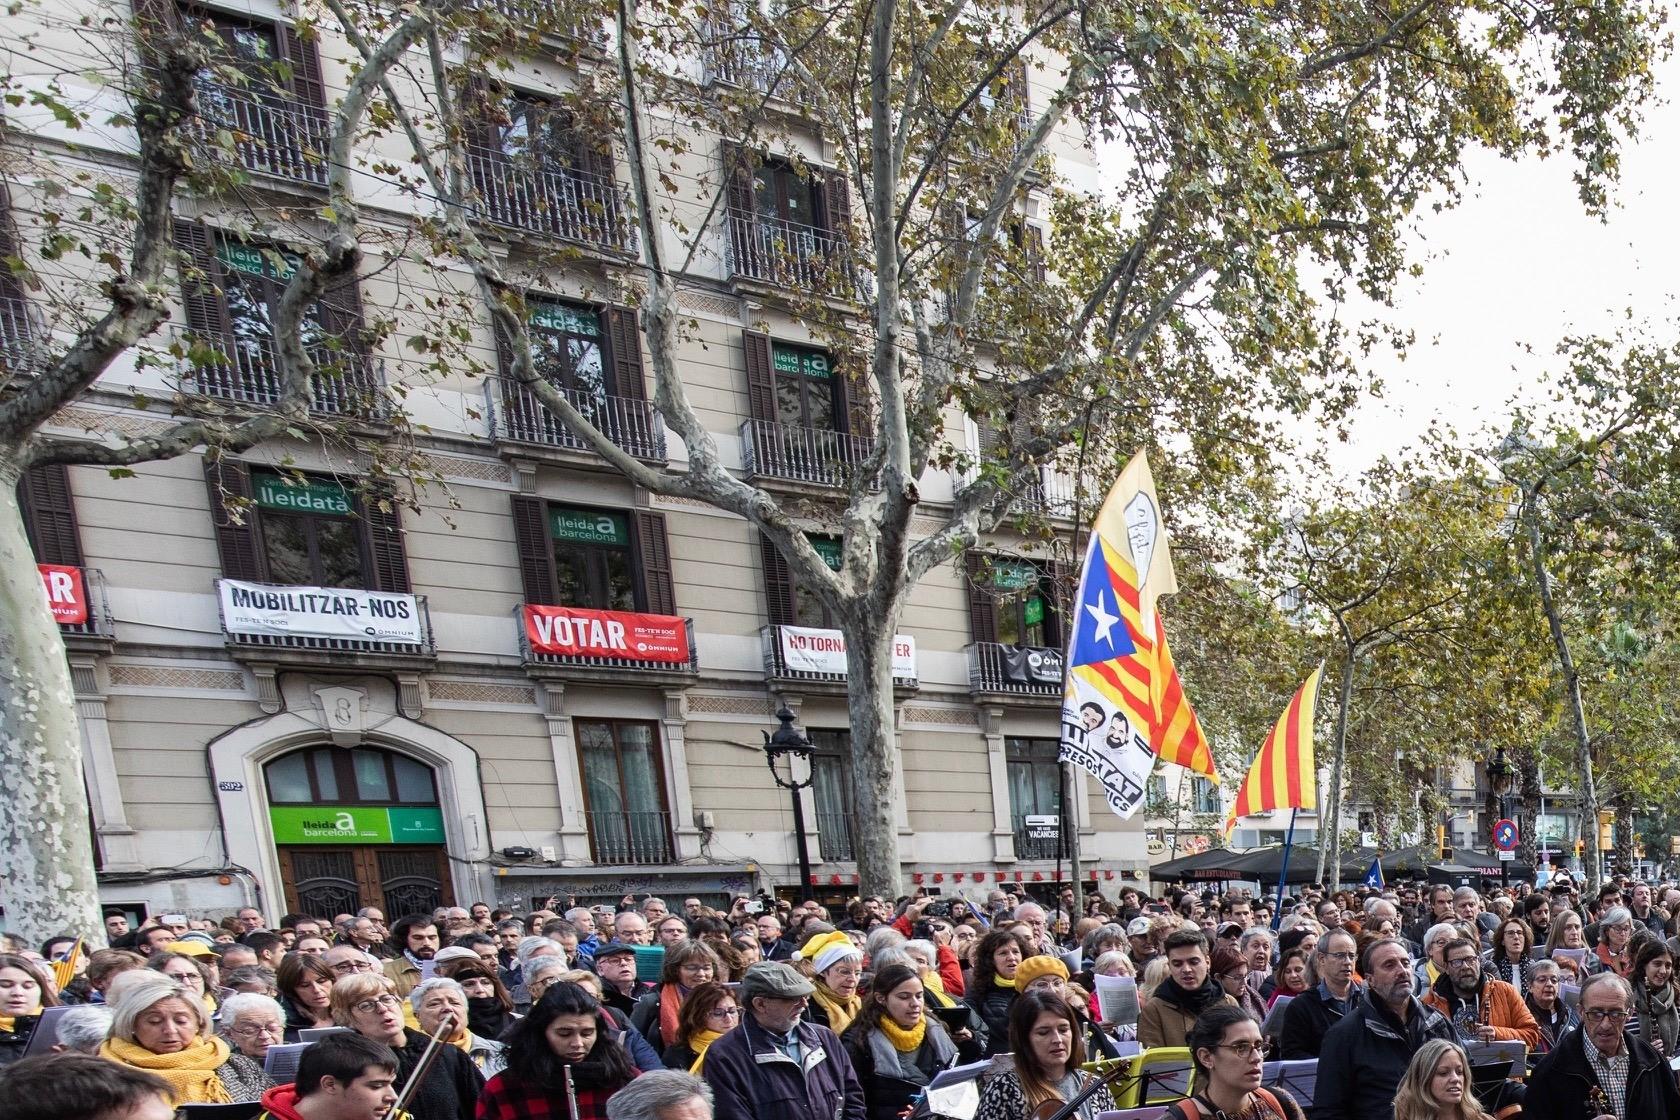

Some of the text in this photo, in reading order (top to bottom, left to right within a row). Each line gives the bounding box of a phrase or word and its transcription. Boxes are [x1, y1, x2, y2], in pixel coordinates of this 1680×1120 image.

[773, 350, 810, 366] lleida
[260, 486, 349, 512] lleidatà
[557, 516, 594, 530] lleida
[559, 528, 617, 543] barcelona
[231, 587, 410, 619] MOBILITZAR-NOS
[533, 614, 627, 650] VOTAR
[302, 820, 336, 829] lleida
[303, 827, 358, 837] barcelona
[1028, 830, 1059, 839] VACANCIES
